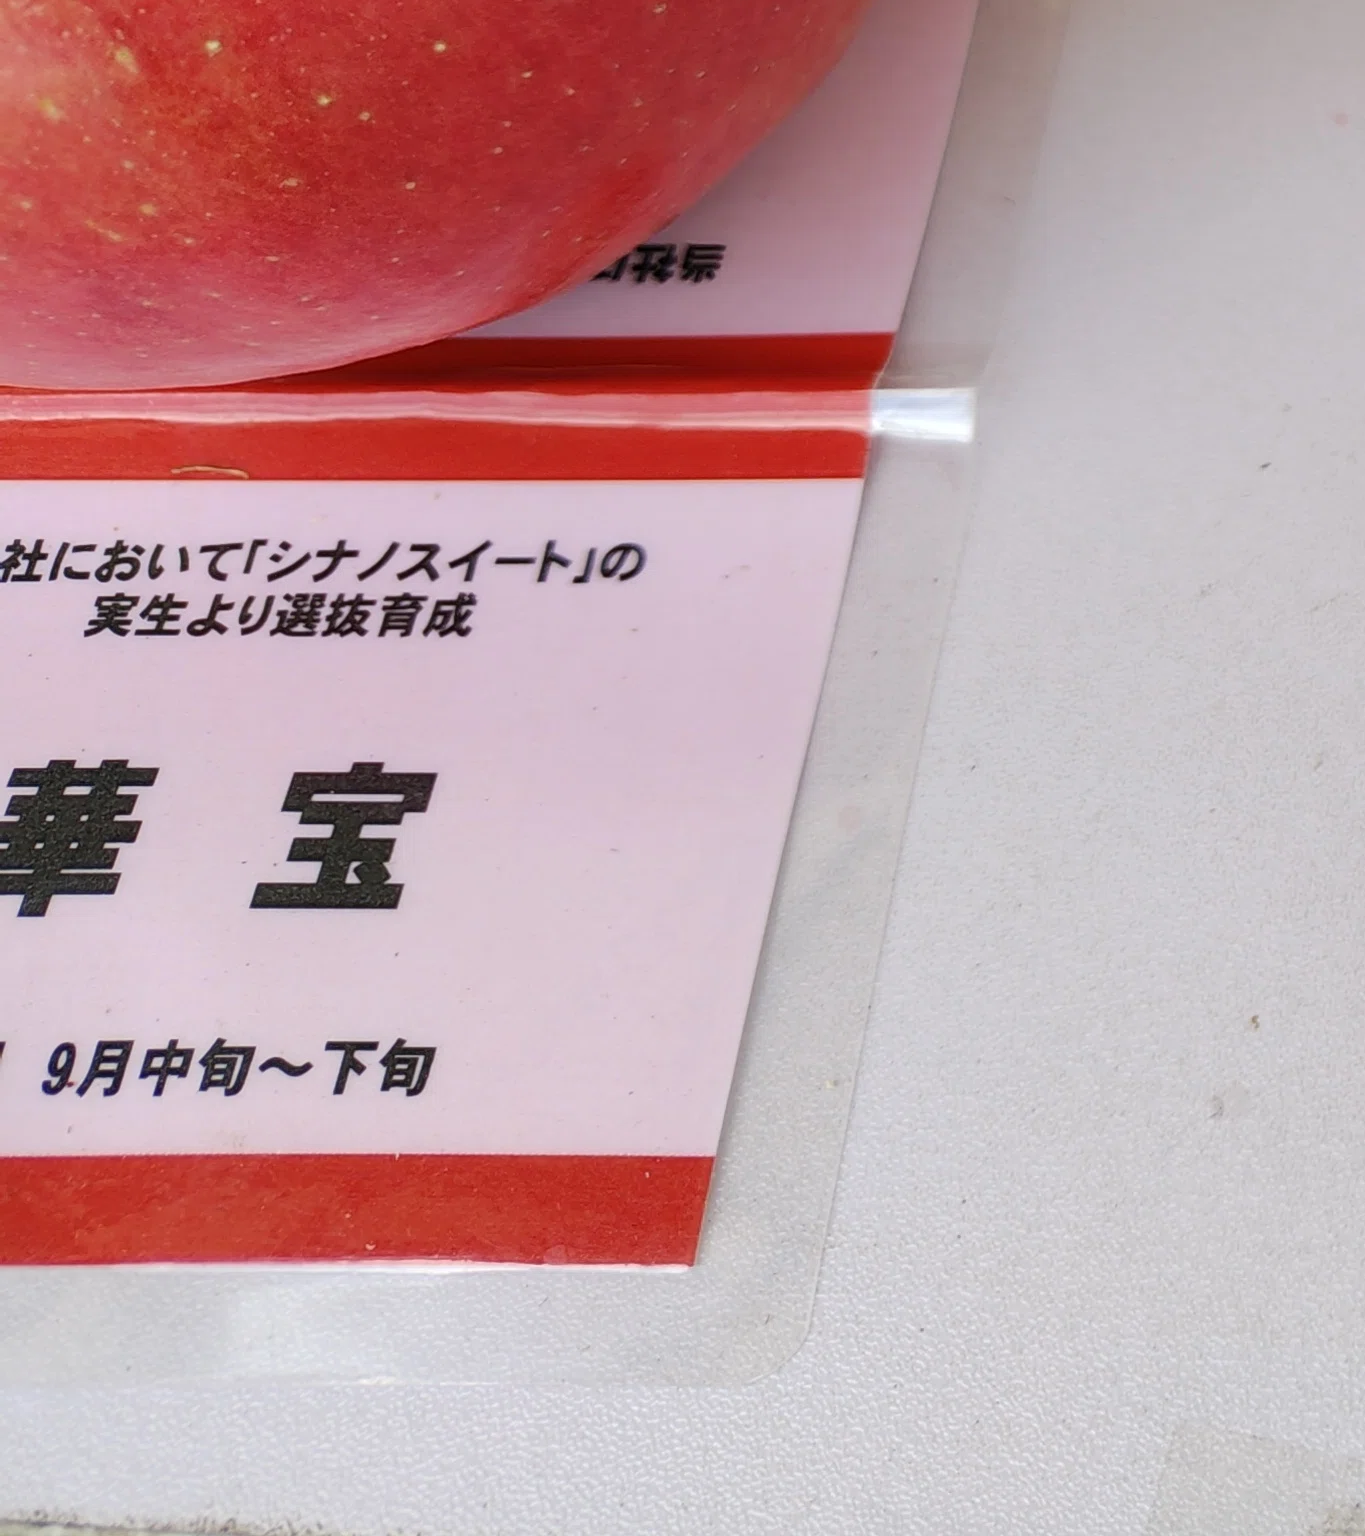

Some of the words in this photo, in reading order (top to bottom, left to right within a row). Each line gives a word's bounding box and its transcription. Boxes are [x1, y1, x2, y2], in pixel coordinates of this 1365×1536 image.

[83, 592, 476, 639] 実生より選抜育成
